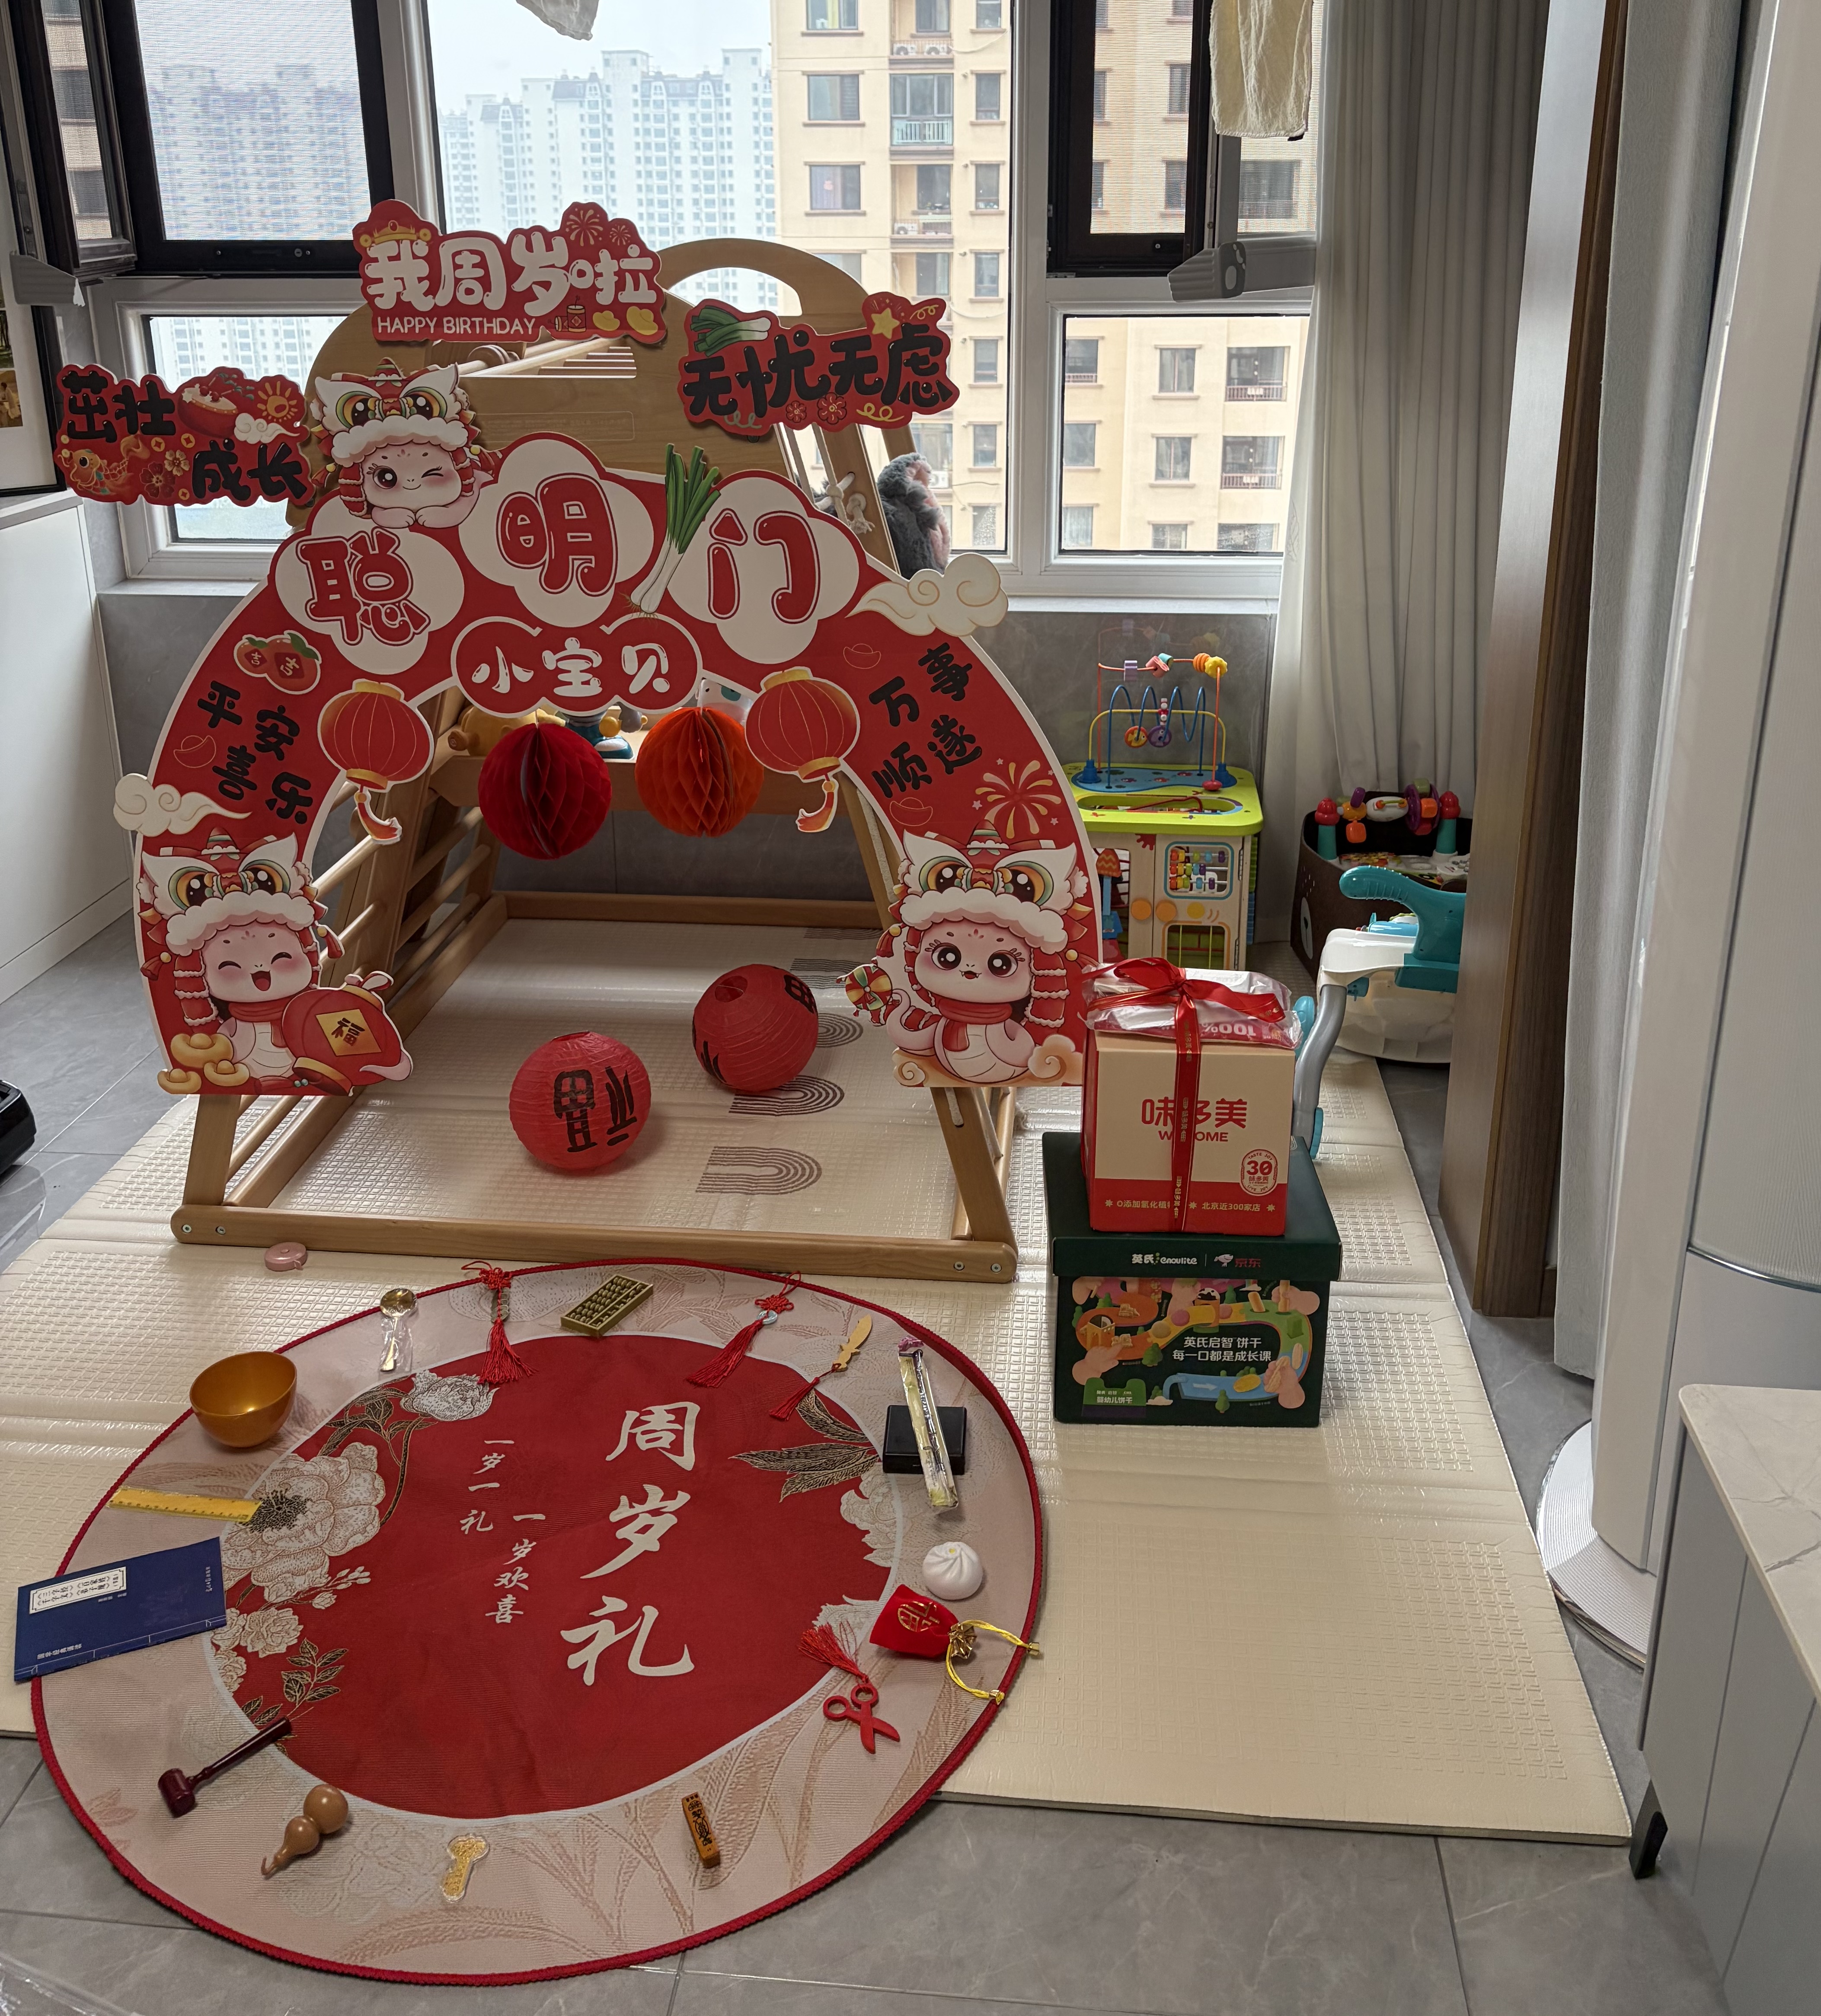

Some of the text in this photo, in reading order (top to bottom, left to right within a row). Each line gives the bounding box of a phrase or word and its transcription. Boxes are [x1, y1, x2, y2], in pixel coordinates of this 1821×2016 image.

[365, 232, 657, 316] 我周岁啦
[378, 316, 536, 335] HAPPY BIRTHDAY
[61, 370, 176, 443] 茁壮
[683, 323, 952, 418] 无忧无虑
[192, 438, 308, 501] 成长
[296, 472, 821, 646] 聪明门
[251, 652, 261, 665] 吉
[280, 657, 300, 676] 吉
[472, 637, 671, 697] 小宝贝
[869, 642, 973, 727] 万事
[197, 680, 300, 761] 平安
[871, 714, 982, 798] 顺遂
[212, 745, 313, 825] 喜乐
[331, 1017, 366, 1046] 福
[1246, 1160, 1272, 1176] 30
[1132, 1254, 1154, 1264] 英氏
[1234, 1258, 1262, 1268] 京东
[1172, 1349, 1272, 1362] 每一口都是成长课
[460, 1439, 514, 1534] 一岁一礼
[485, 1513, 546, 1624] 一岁欢喜
[560, 1401, 701, 1686] 周岁礼
